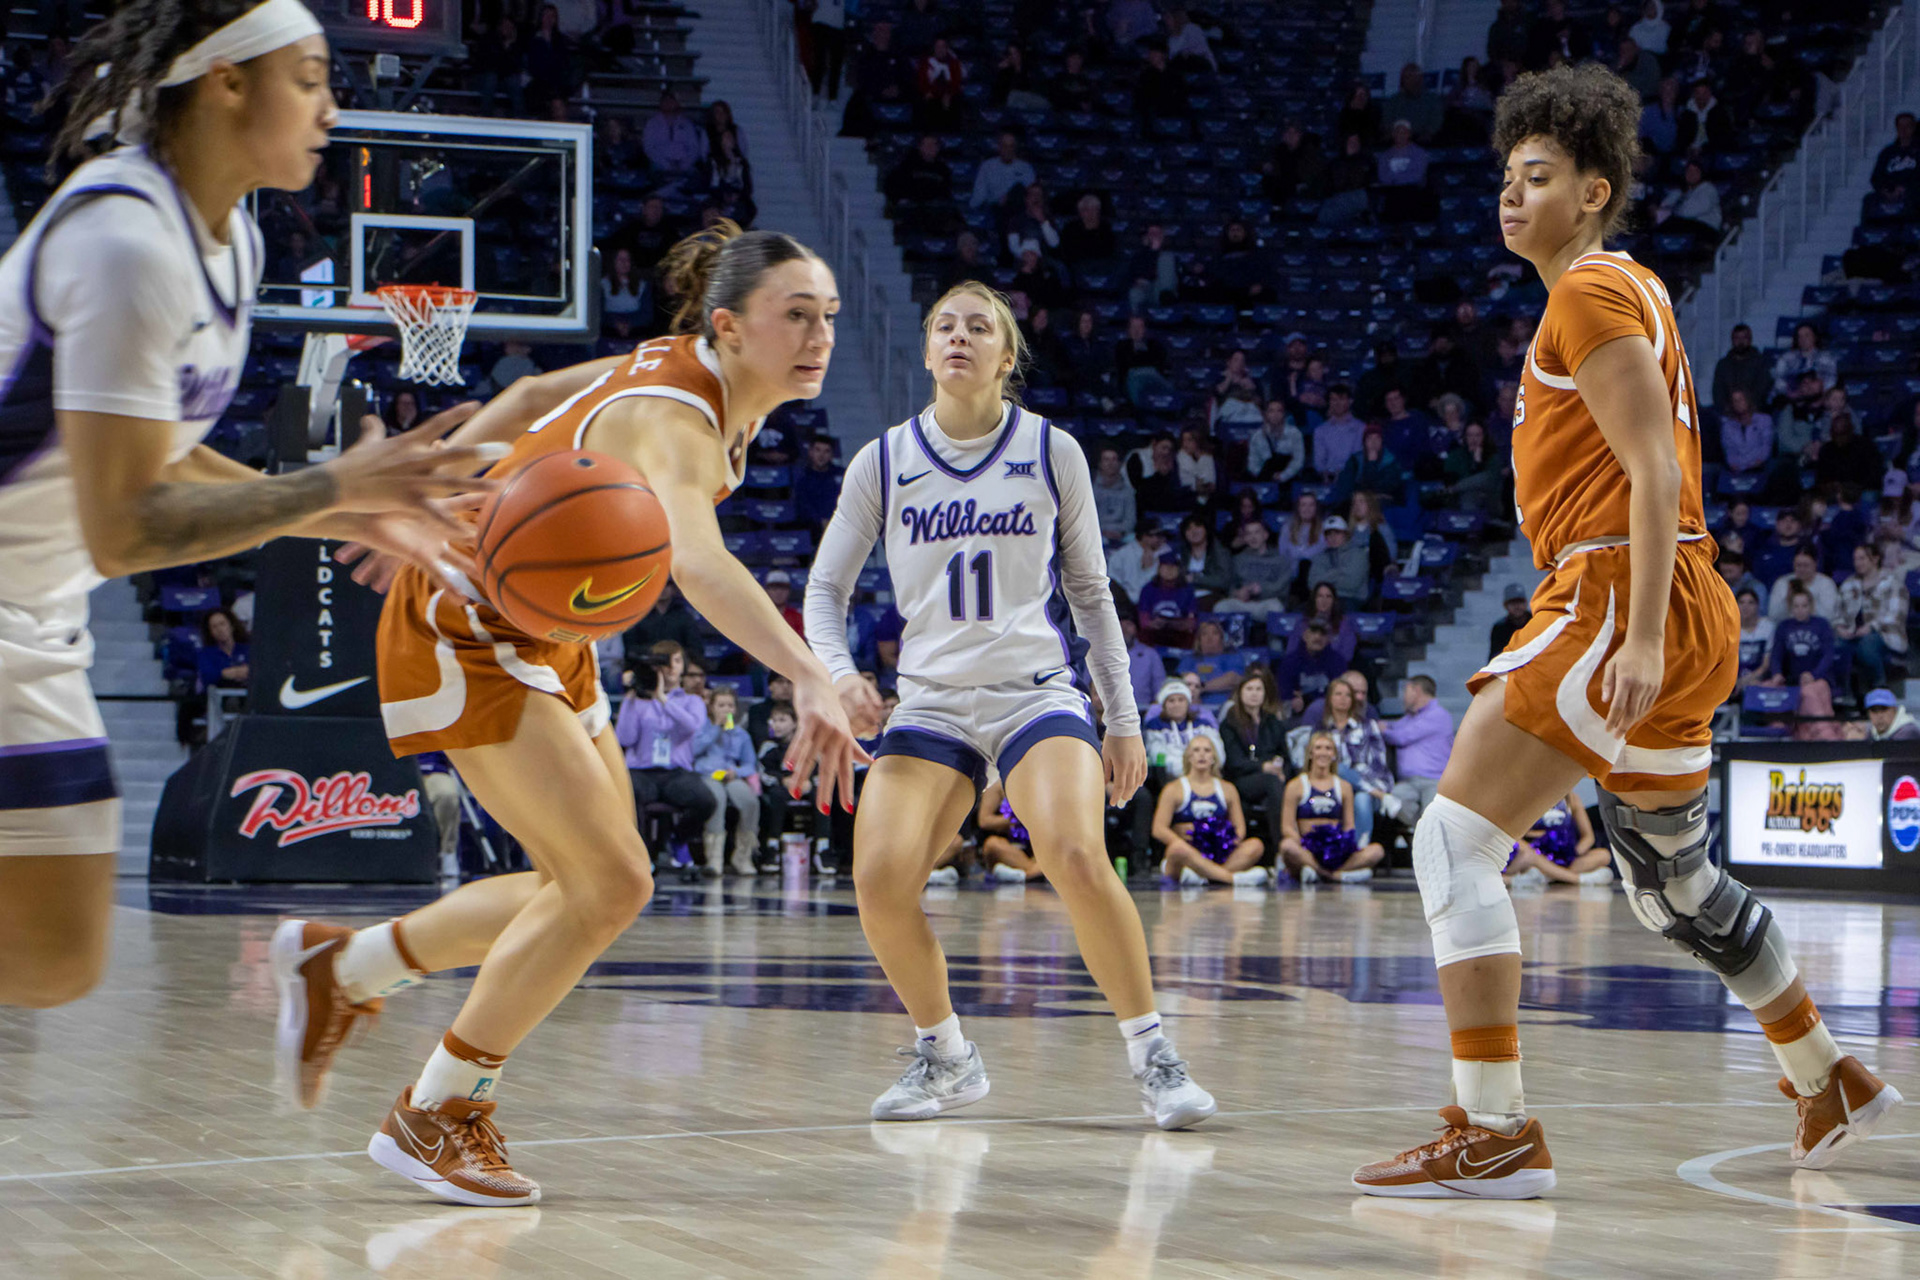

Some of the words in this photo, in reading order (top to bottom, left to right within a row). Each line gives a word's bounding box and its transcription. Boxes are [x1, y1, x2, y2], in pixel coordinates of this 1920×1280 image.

[1004, 460, 1037, 480] XII
[901, 498, 1037, 546] Wildcats
[317, 538, 334, 669] LDCATS
[946, 549, 994, 621] 11
[230, 769, 420, 840] Dillons
[1767, 769, 1844, 832] Briggs
[1799, 844, 1847, 858] HEADQUARTERS
